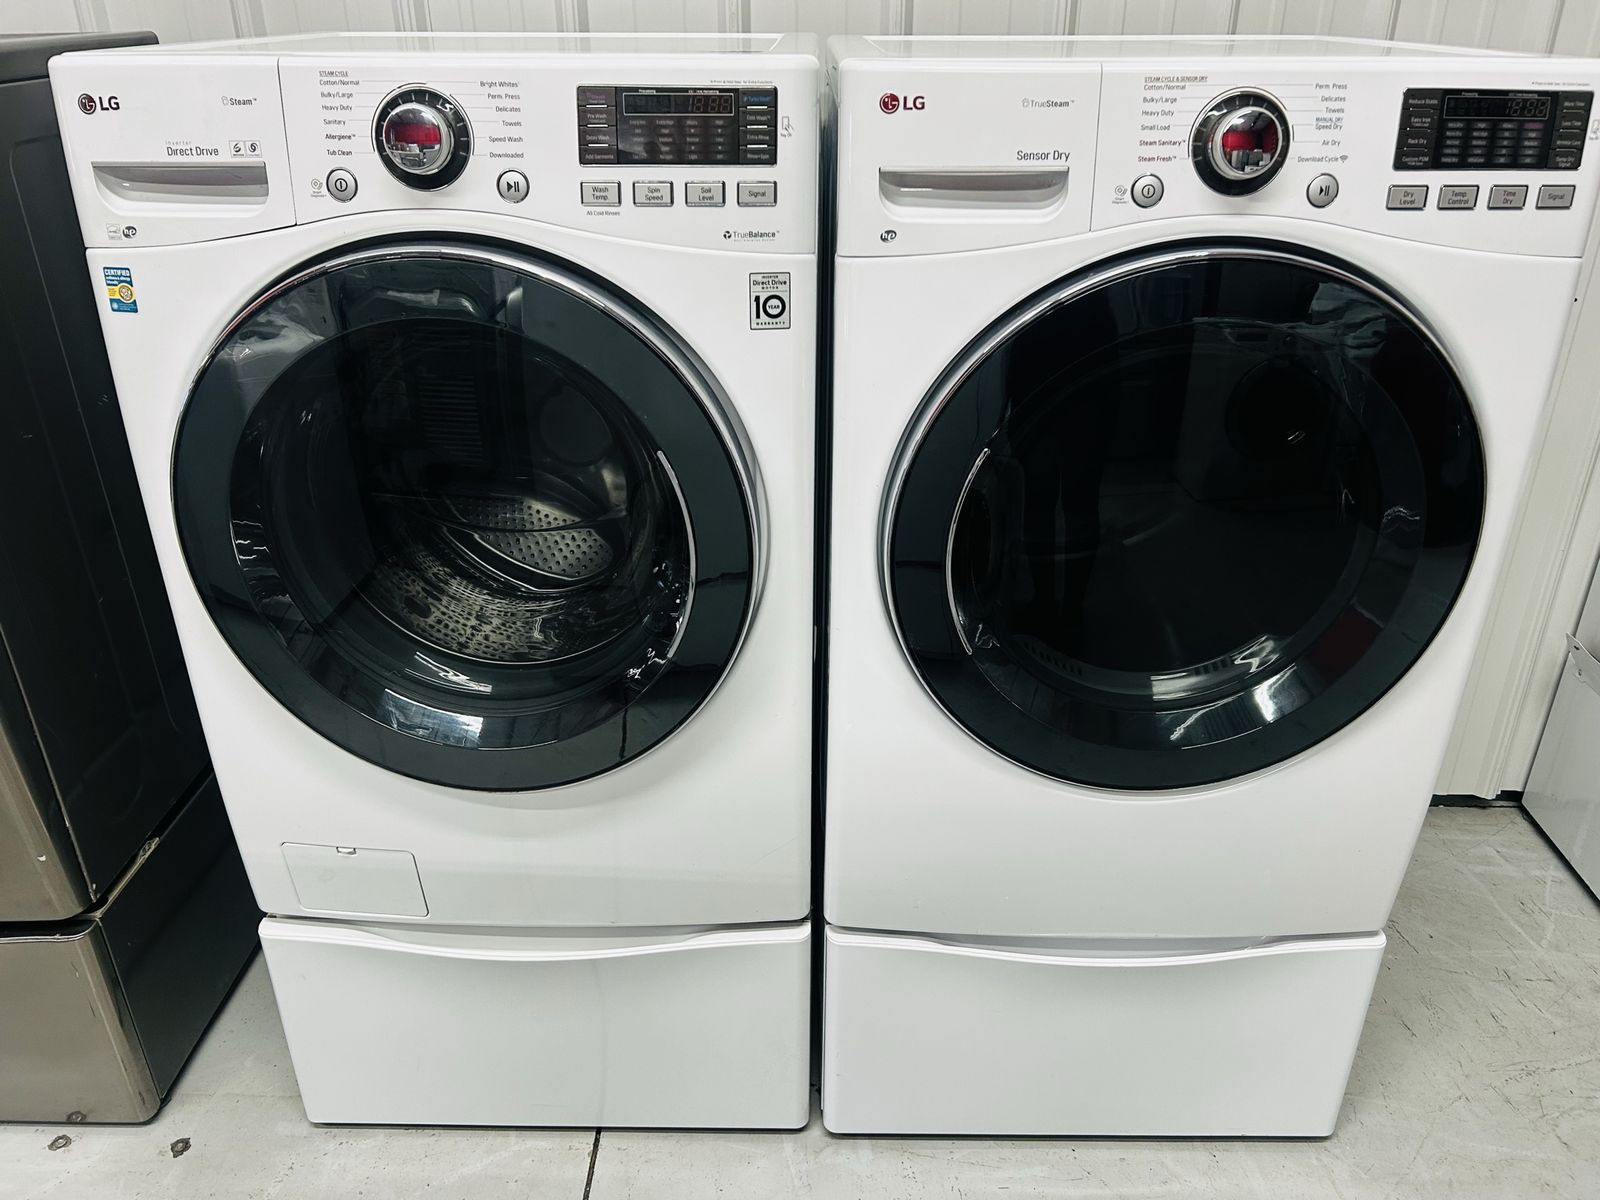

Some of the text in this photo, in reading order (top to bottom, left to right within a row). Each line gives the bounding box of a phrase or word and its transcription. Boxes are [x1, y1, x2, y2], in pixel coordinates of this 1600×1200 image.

[98, 96, 120, 111] LG
[903, 96, 926, 110] LG
[166, 146, 220, 156] Direct Drive
[1016, 150, 1070, 163] Sensor Dry
[748, 190, 766, 198] Signal
[1548, 192, 1566, 200] Signal
[754, 294, 786, 320] 10
